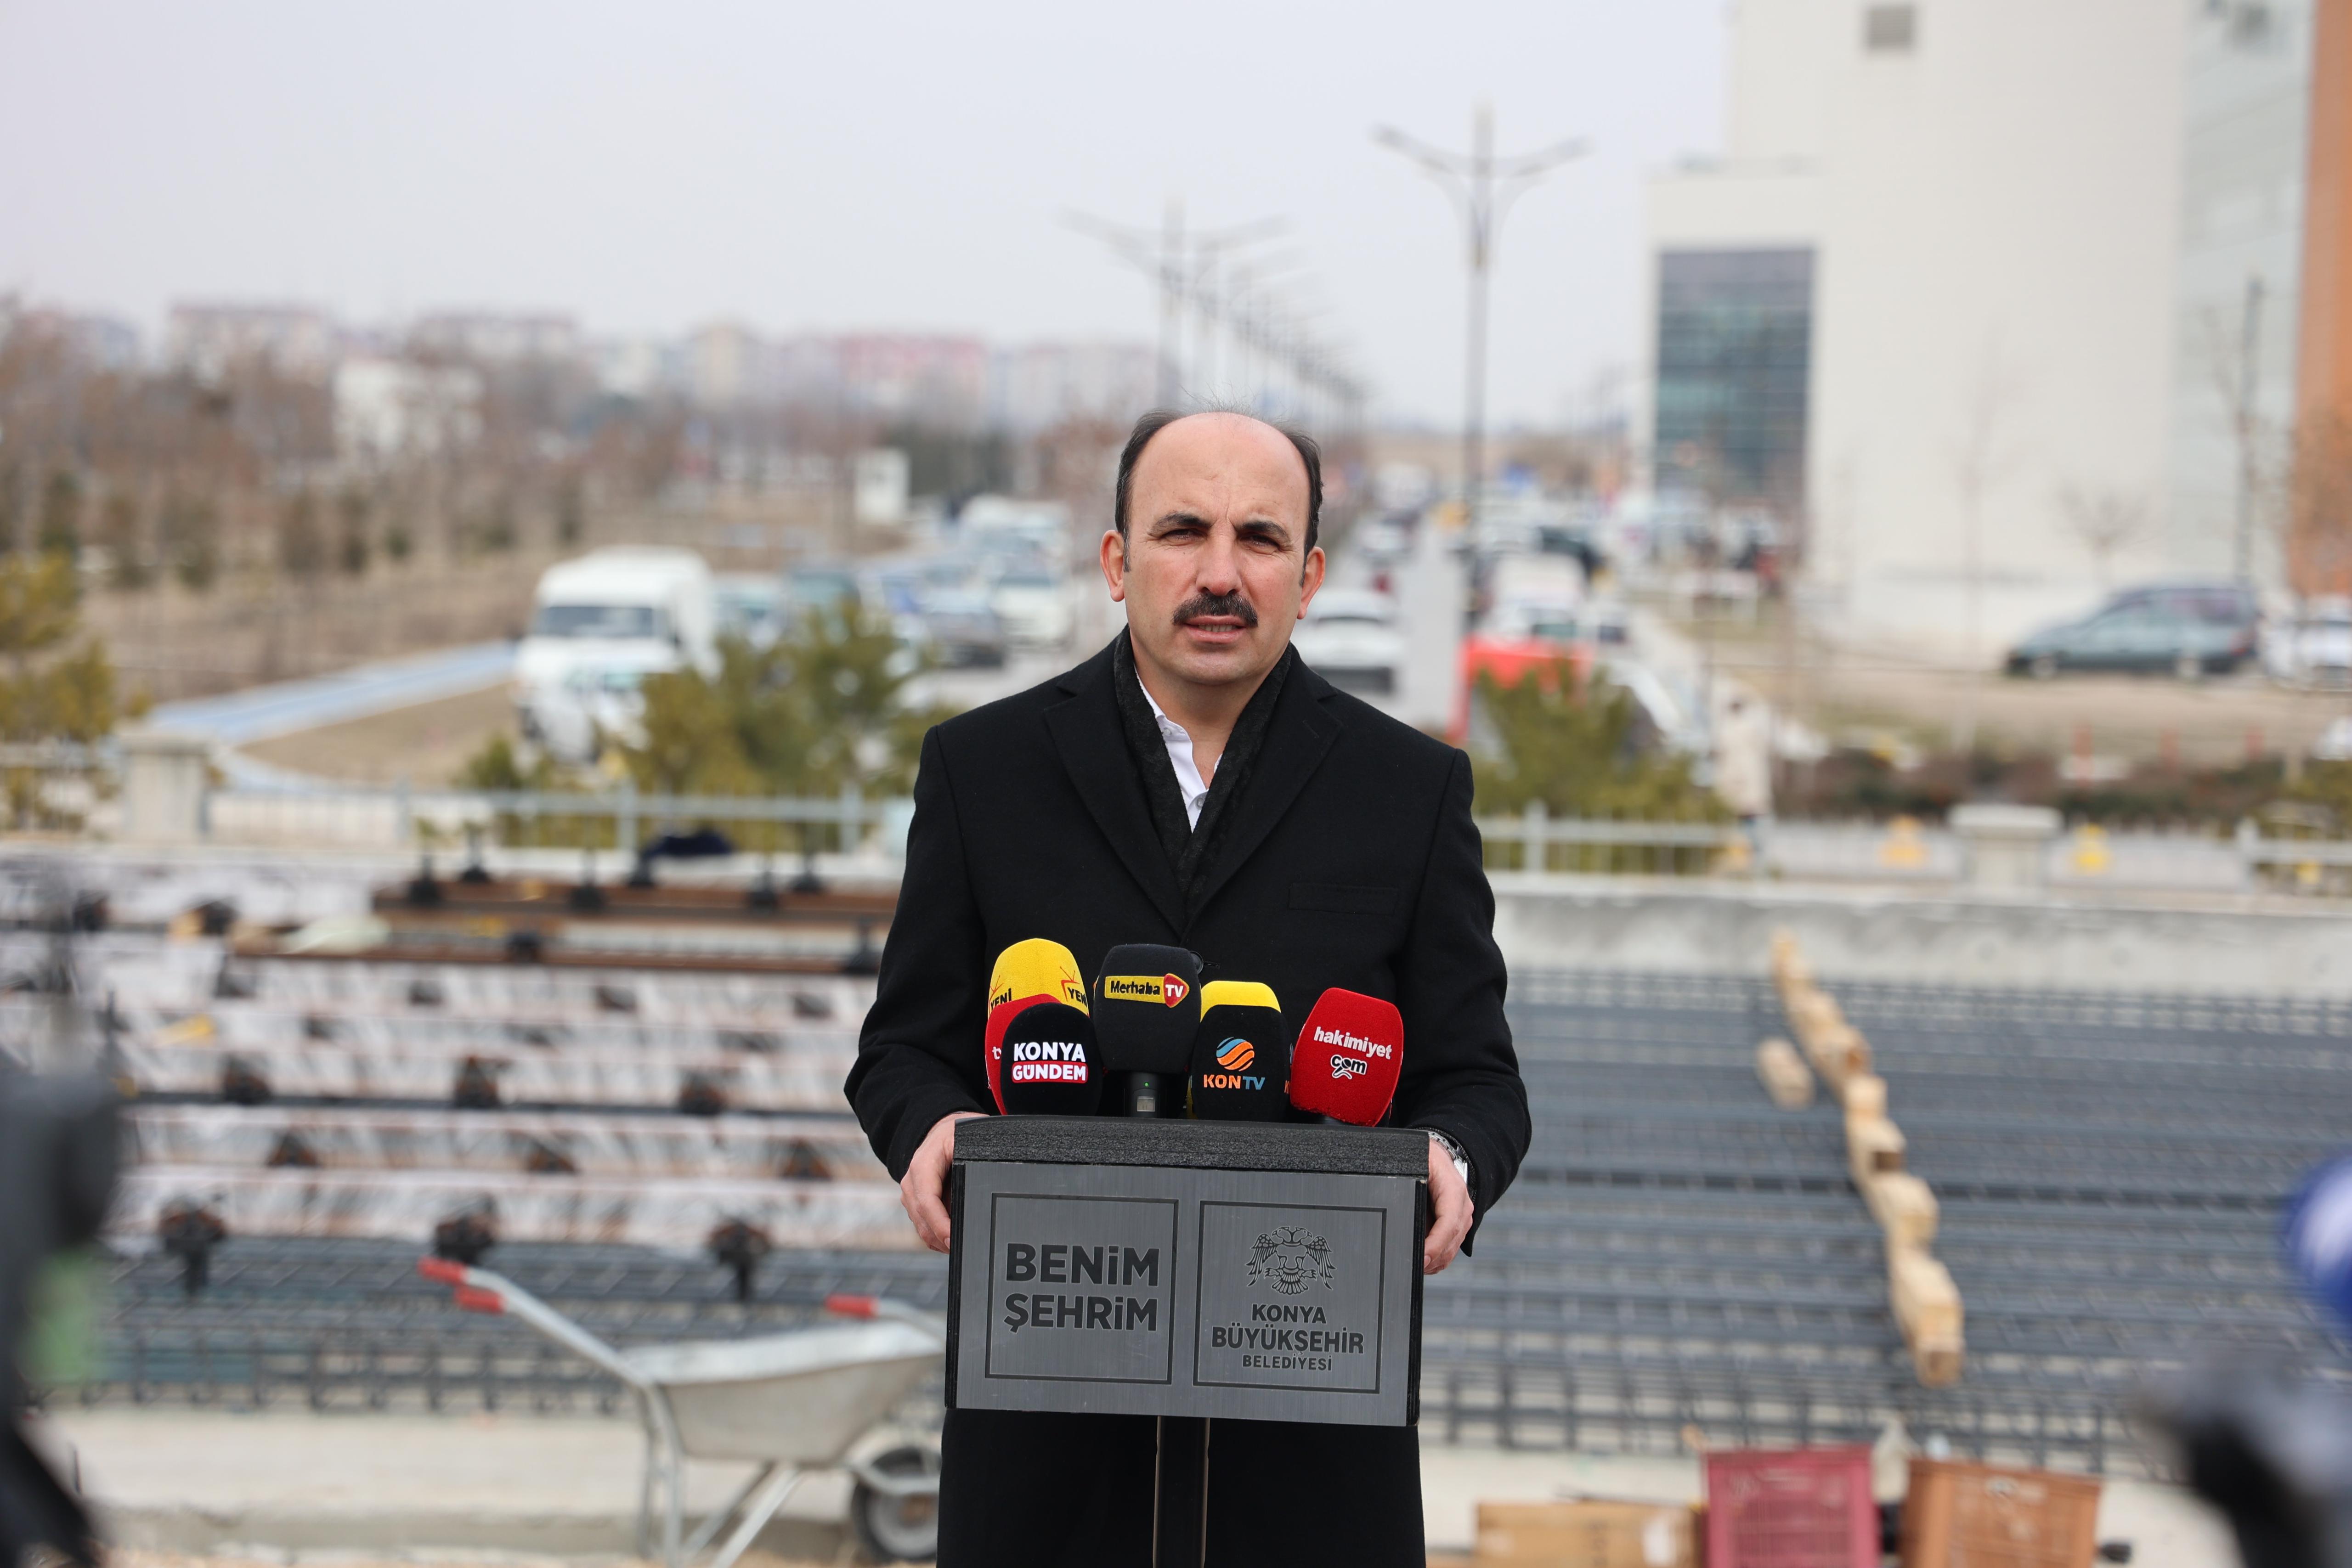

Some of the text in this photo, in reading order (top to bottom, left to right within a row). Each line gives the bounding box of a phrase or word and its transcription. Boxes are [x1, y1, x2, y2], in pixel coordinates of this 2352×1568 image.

[1110, 980, 1183, 998] Merhaba TV
[1014, 1042, 1086, 1062] KONYA
[1313, 1026, 1392, 1060] hakimiyet
[1012, 1064, 1086, 1081] GÜNDEM
[1252, 1303, 1327, 1324] KONYA
[1211, 1322, 1364, 1355] BÜYÜKŞEHİR
[1242, 1353, 1332, 1371] BELEDİYESİ
